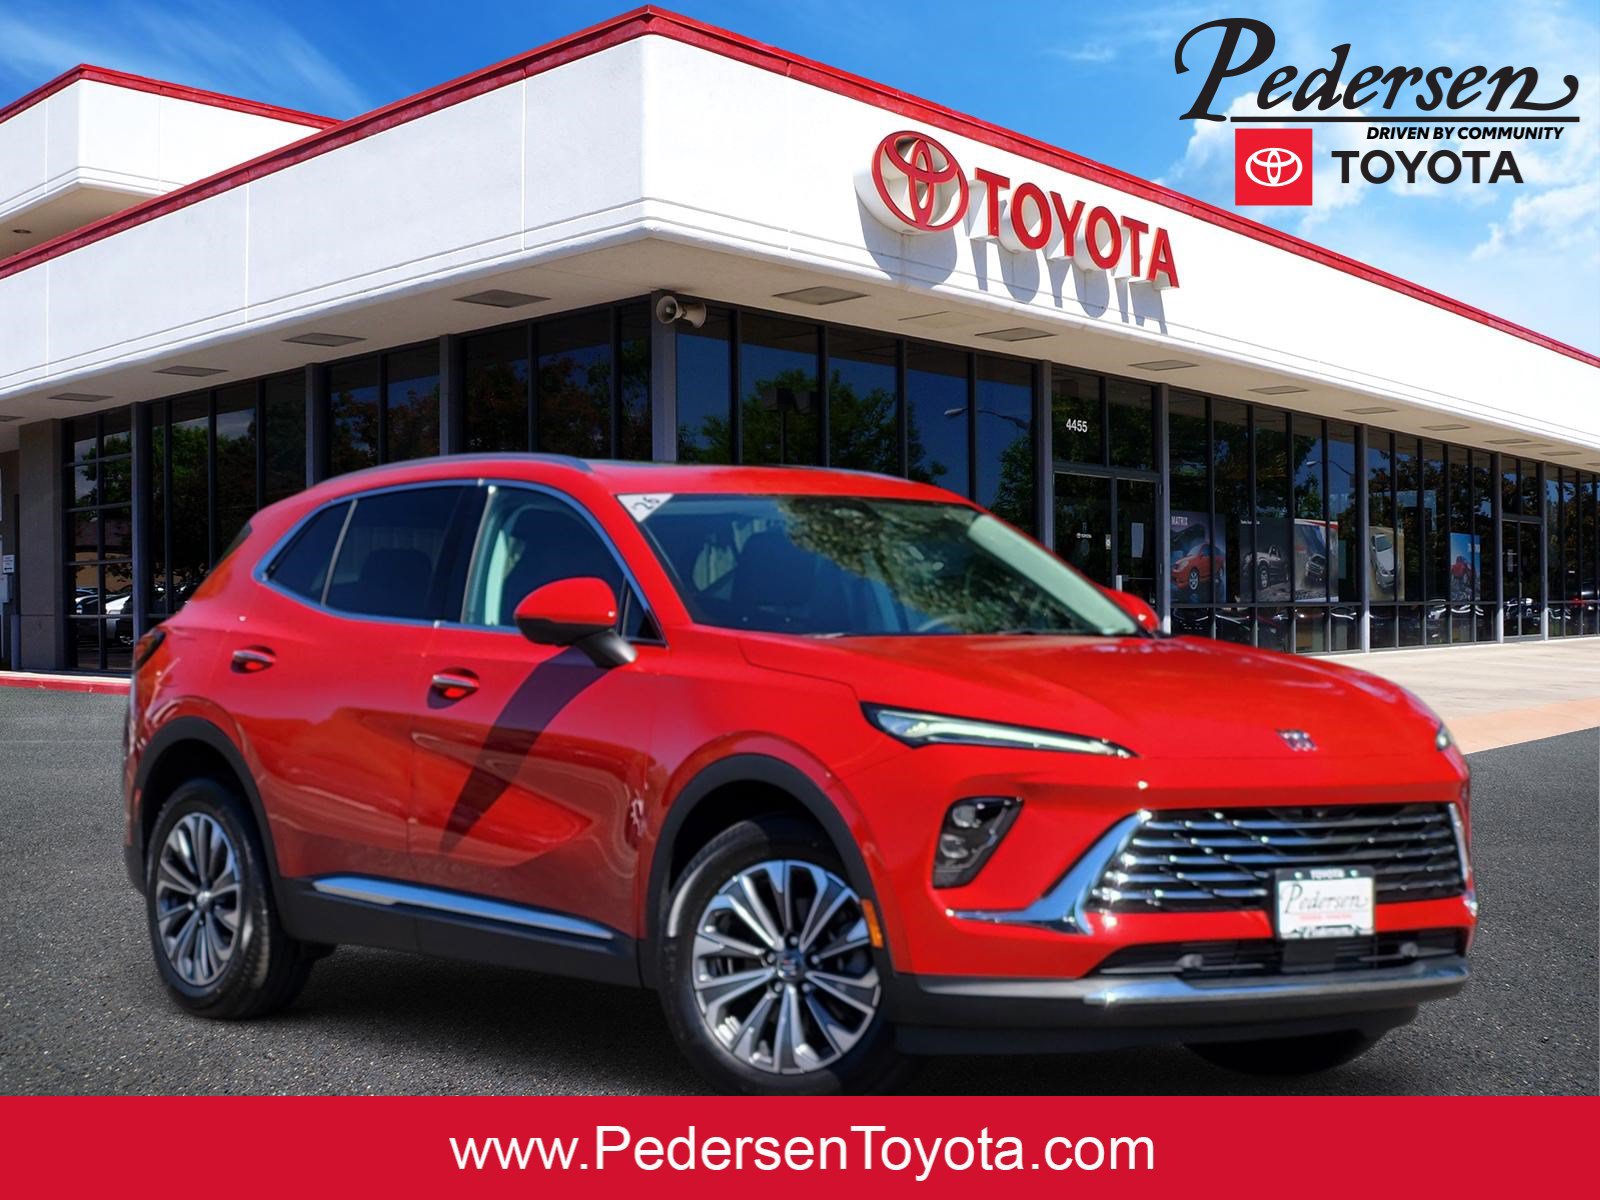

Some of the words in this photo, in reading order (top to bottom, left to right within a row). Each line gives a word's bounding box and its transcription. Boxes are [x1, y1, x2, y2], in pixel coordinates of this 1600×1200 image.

[975, 167, 1180, 288] TOYOTA
[1065, 418, 1088, 433] 4455
[1281, 883, 1370, 914] Pedersen
